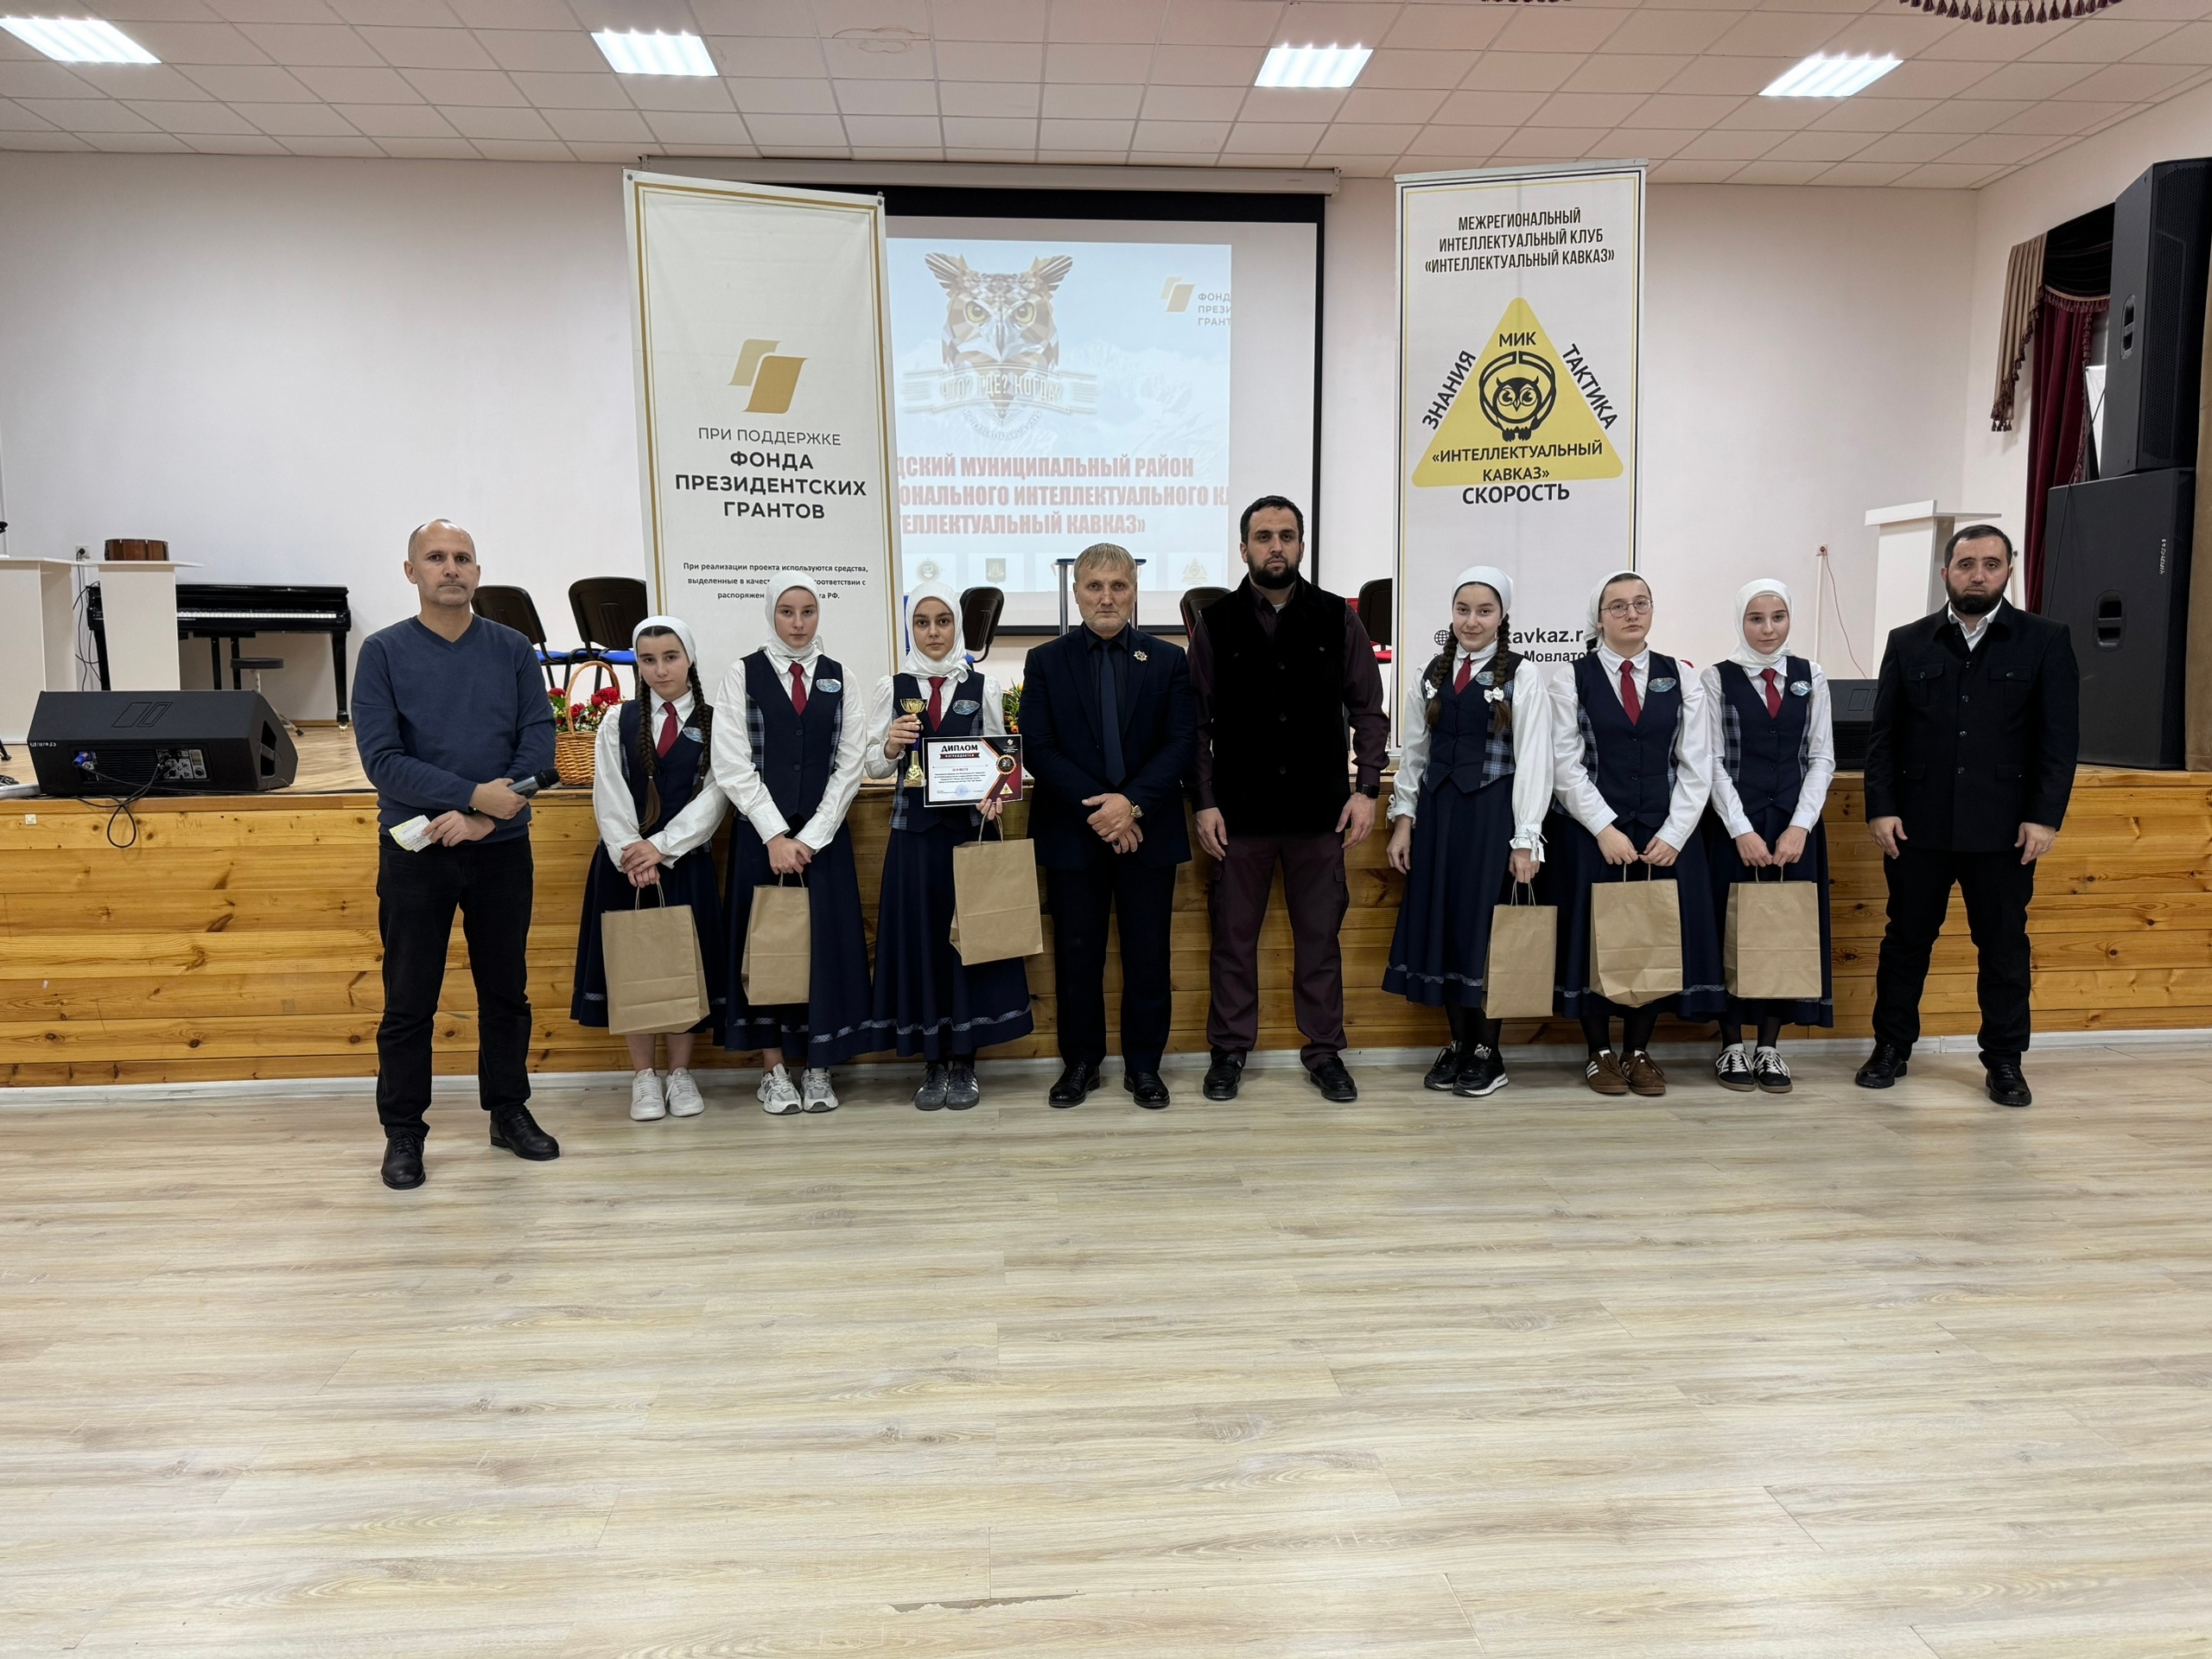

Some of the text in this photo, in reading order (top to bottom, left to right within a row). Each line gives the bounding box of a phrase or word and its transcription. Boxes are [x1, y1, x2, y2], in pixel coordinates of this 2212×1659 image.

[1459, 207, 1581, 231] МЕЖРЕГИОНАЛЬНЫЙ
[1439, 228, 1604, 252] ИНТЕЛЛЕКТУАЛЬНЫЙ КЛУБ
[1425, 248, 1615, 273] «ИНТЕЛЛЕКТУАЛЬНЫЙ КАВКАЗ»
[1498, 332, 1536, 347] МИК
[941, 373, 1063, 403] ЧТО? ГДЕ? КОГДА?
[1421, 350, 1477, 429] ЗНАНИЯ
[1562, 343, 1618, 429] ТАКТИКА
[698, 428, 842, 446] ПРИ ПОДДЕРЖКЕ
[730, 451, 814, 472] ФОНДА
[1432, 439, 1603, 462] «ИНТЕЛЛЕКТУАЛЬНЫЙ
[961, 453, 1131, 480] МУНИЦИПАЛЬНЫЙ
[1135, 454, 1193, 477] РАЙОН
[1483, 467, 1549, 481] КАВКАЗ»
[676, 474, 867, 496] ПРЕЗИДЕНТСКИХ
[899, 486, 1009, 506] ОНАЛЬНОГО
[1014, 485, 1208, 506] ИНТЕЛЛЕКТУАЛЬНОГО
[1462, 483, 1570, 505] СКОРОСТЬ
[724, 501, 825, 518] ГРАНТОВ
[901, 511, 1146, 535] ЕЛЛЕКТУАЛЬНЫЙ КАВКАЗ»
[683, 563, 699, 571] При
[1508, 627, 1584, 644] avkaz.r
[941, 744, 978, 753] ДИПЛОМ
